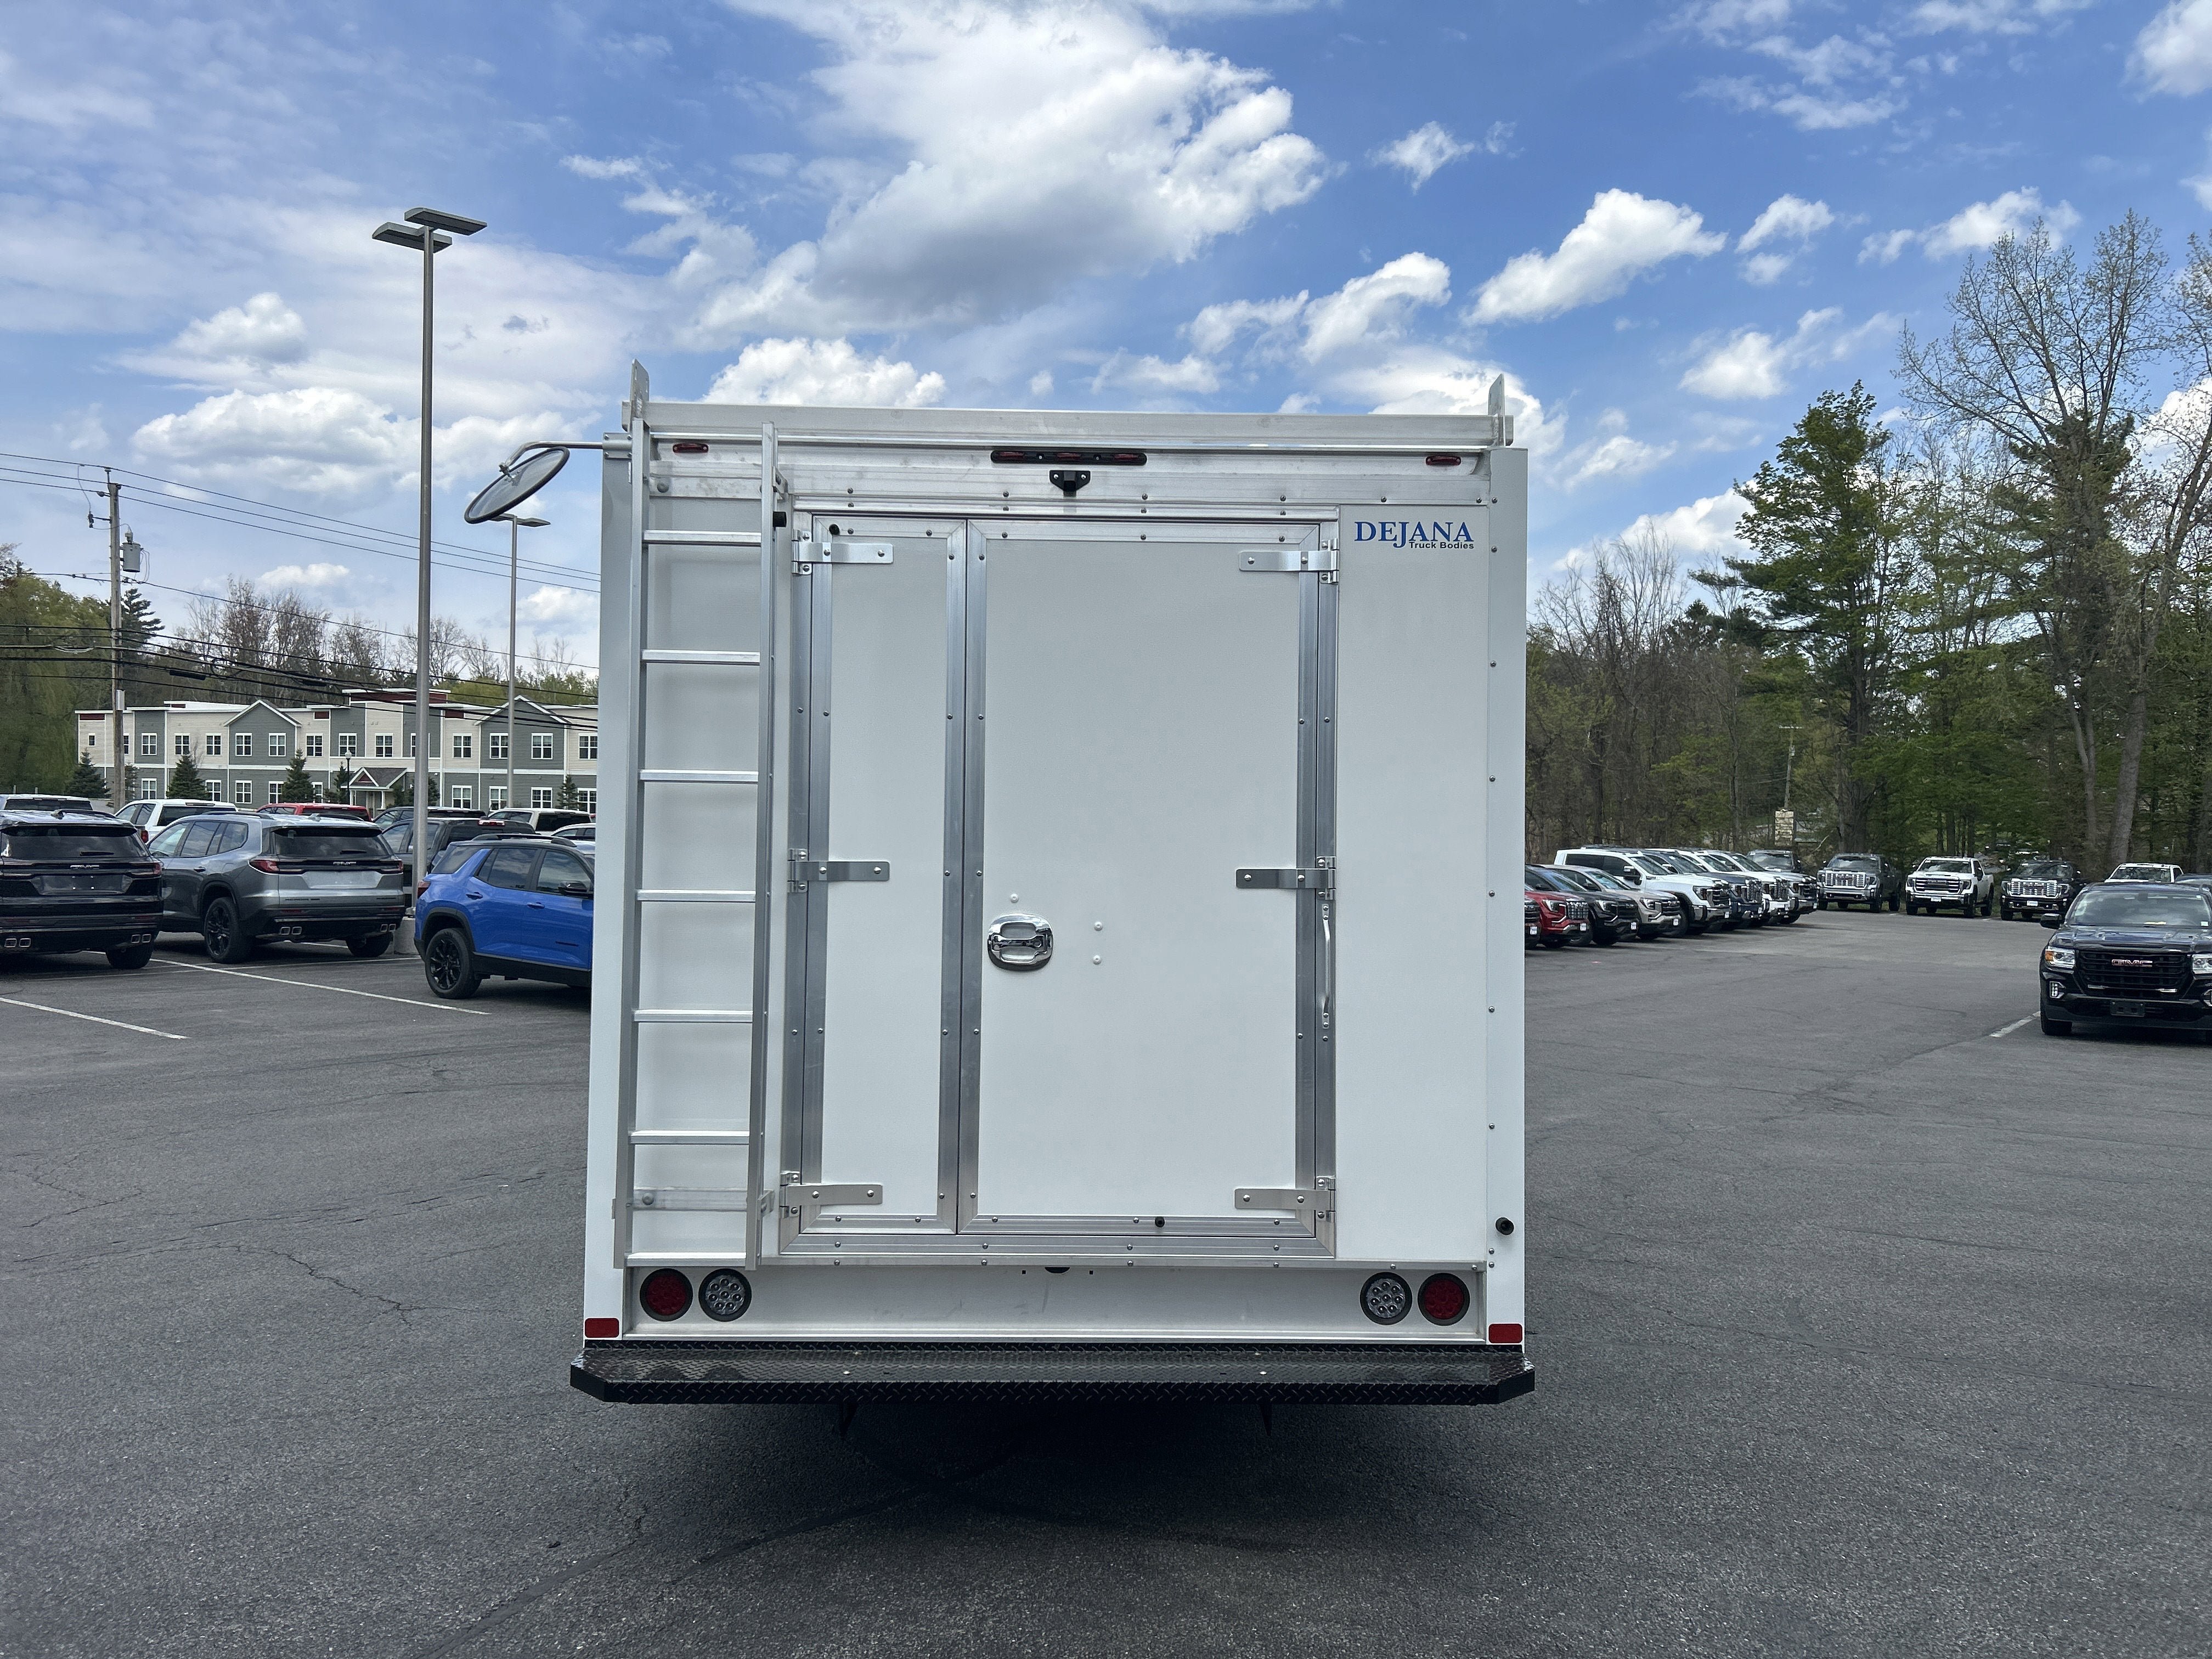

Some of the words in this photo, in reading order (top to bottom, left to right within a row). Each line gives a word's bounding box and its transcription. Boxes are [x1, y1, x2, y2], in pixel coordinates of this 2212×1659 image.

[1354, 521, 1475, 548] DEJANA
[1408, 541, 1437, 549] Truck
[1440, 541, 1475, 550] Bodies
[2111, 959, 2153, 967] GMC
